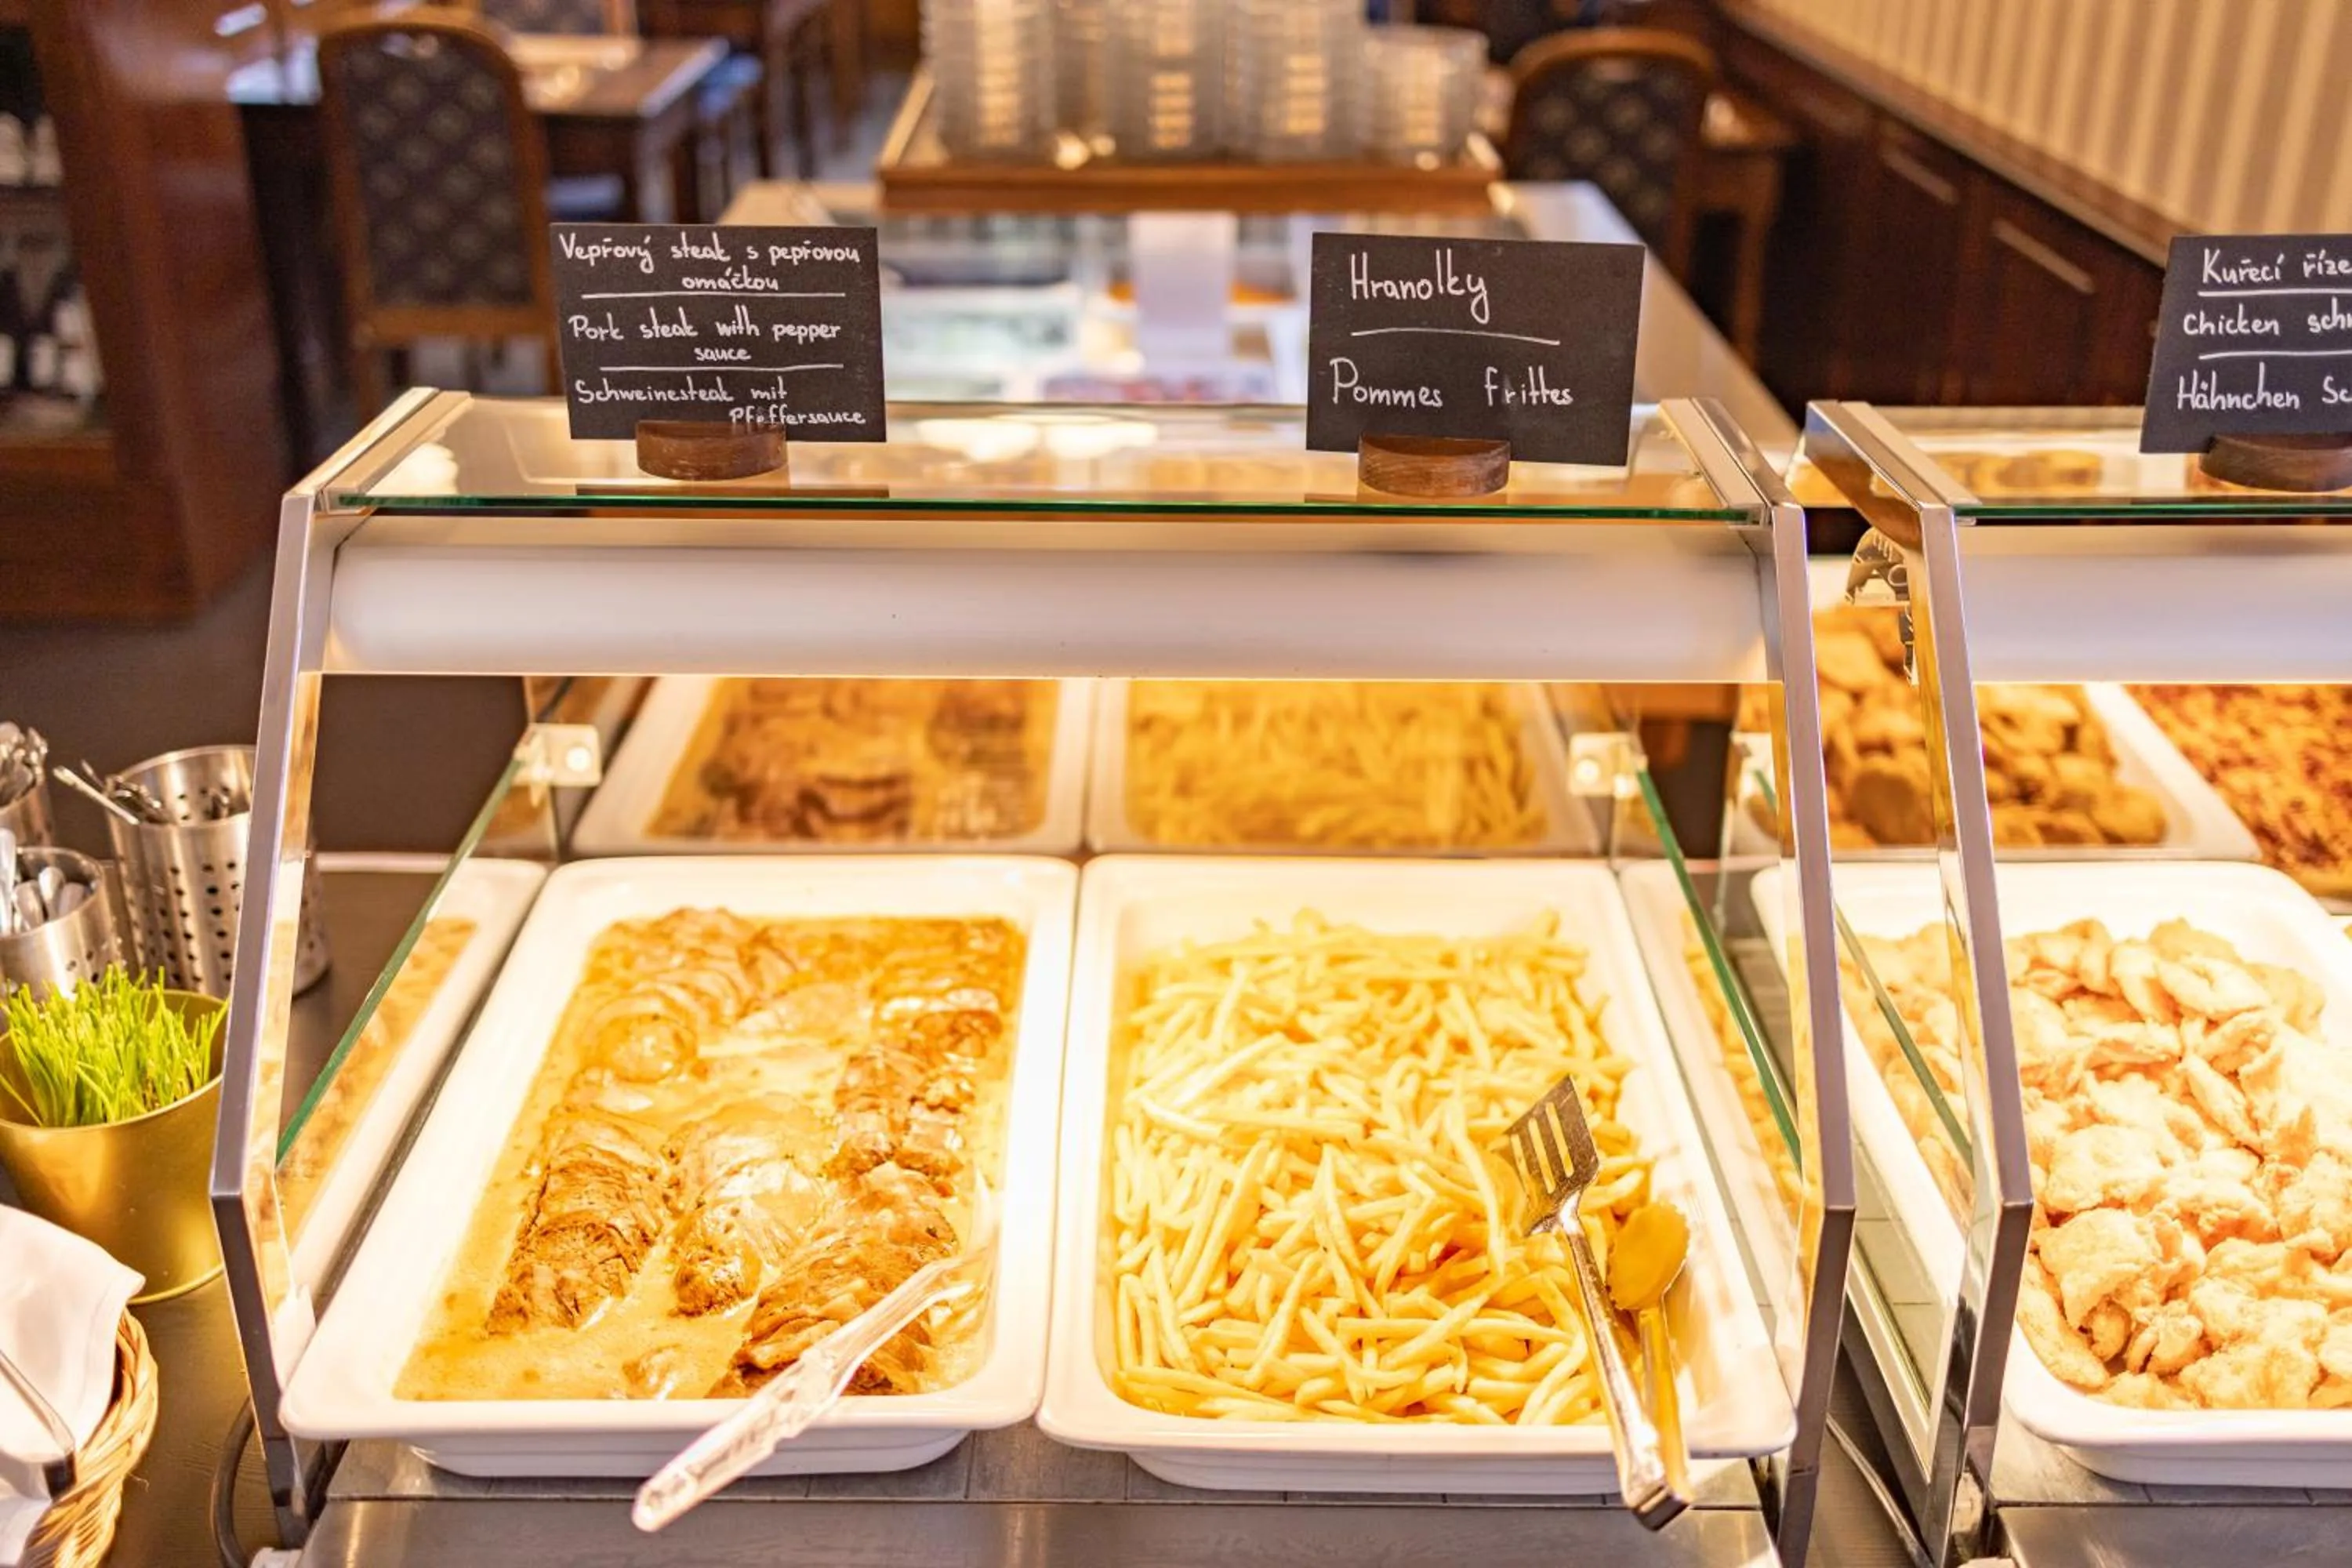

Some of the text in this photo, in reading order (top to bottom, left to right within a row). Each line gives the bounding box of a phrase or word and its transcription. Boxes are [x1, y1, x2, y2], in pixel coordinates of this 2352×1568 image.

[559, 231, 861, 273] Vepřový steak s pepřovou
[2202, 248, 2285, 284] Kuřecí
[681, 265, 779, 290] omáčkou
[1351, 248, 1489, 324] Hranolky
[568, 304, 840, 344] Pork steak with pepper
[694, 347, 752, 361] sauce
[575, 376, 787, 404] Schweinesteak mit
[1330, 358, 1443, 408] Pommes
[2176, 361, 2300, 410] Hähnchen
